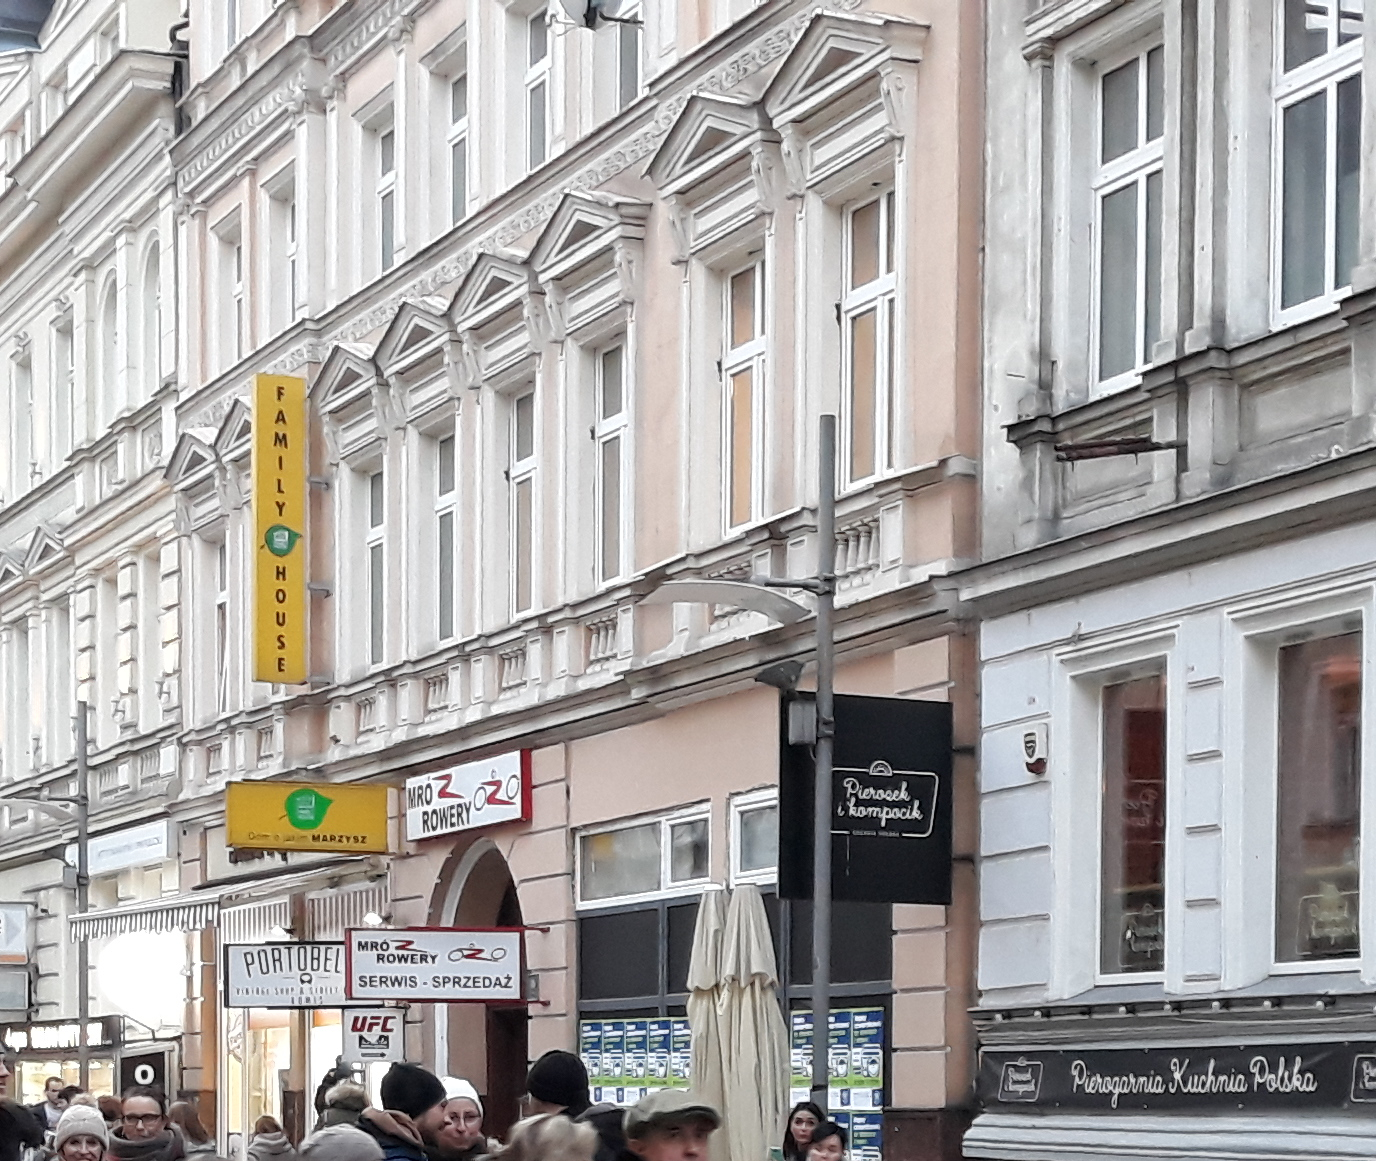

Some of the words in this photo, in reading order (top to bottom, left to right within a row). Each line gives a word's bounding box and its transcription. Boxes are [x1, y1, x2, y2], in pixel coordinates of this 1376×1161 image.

[273, 386, 288, 517] FAMILY
[275, 565, 287, 674] HOUSE
[422, 801, 472, 833] ROWERY
[847, 796, 924, 827] kompocik
[311, 833, 367, 844] MARZYSZ
[243, 945, 341, 978] PORTOBEL
[376, 953, 438, 965] ROWERY
[358, 975, 418, 989] SERWIS
[432, 973, 514, 989] SPRZEDAŻ
[351, 1015, 397, 1033] UFC
[1071, 1060, 1166, 1109] Pierogarnia
[1169, 1058, 1248, 1094] Kuchnia
[1250, 1056, 1318, 1093] Polska
